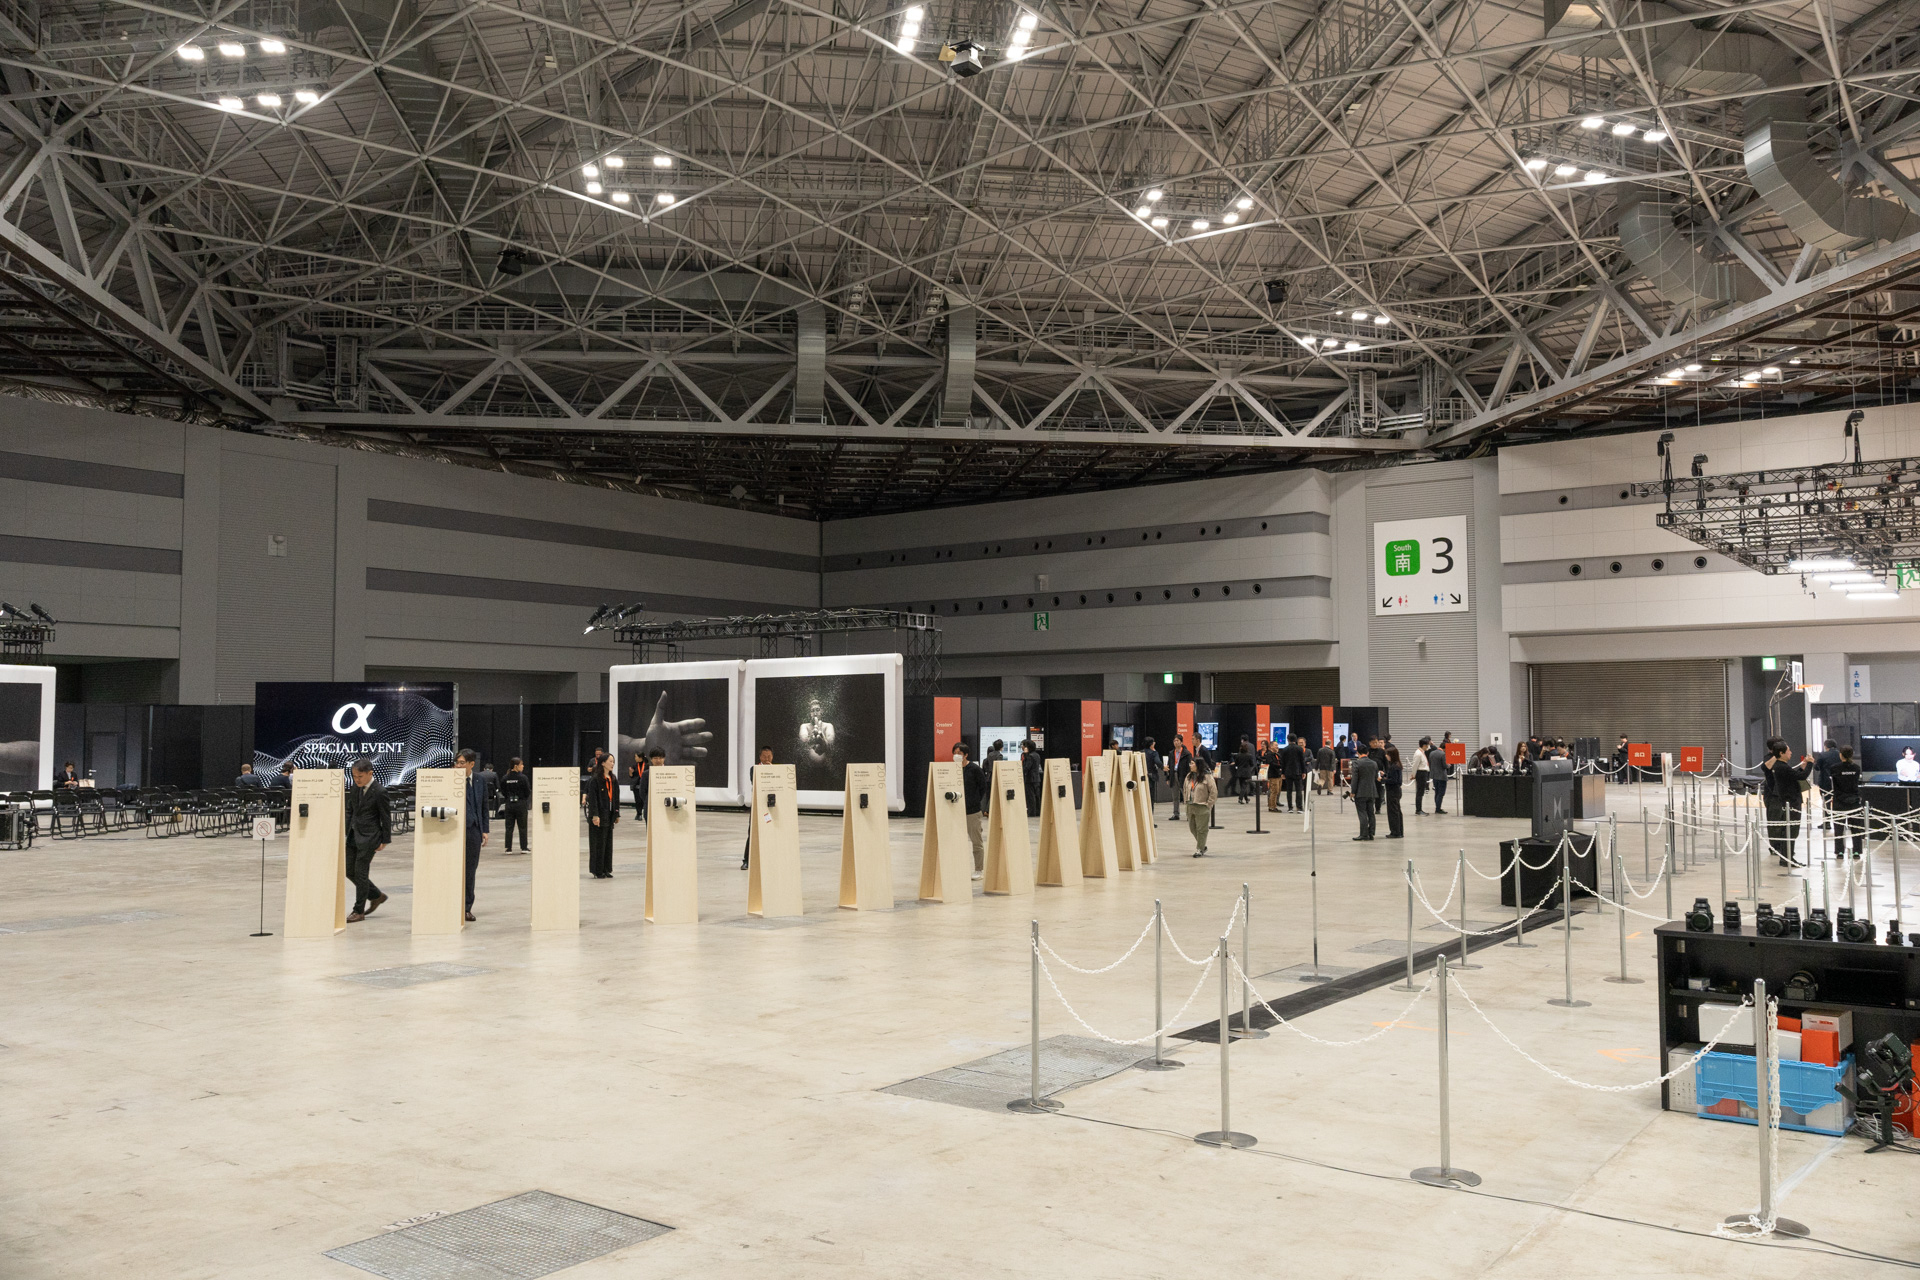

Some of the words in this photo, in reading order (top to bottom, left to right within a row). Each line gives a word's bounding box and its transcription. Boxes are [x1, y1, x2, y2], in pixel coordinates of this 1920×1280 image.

[1393, 544, 1412, 552] South
[1432, 537, 1454, 574] 3
[1395, 553, 1411, 573] 南
[304, 743, 358, 754] SPECIAL
[361, 742, 405, 753] EVENT
[329, 771, 341, 798] 2021
[453, 770, 464, 798] 2019
[569, 768, 579, 796] 2018
[685, 768, 695, 794] 2017
[786, 766, 796, 791] 2017
[877, 765, 886, 790] 2016
